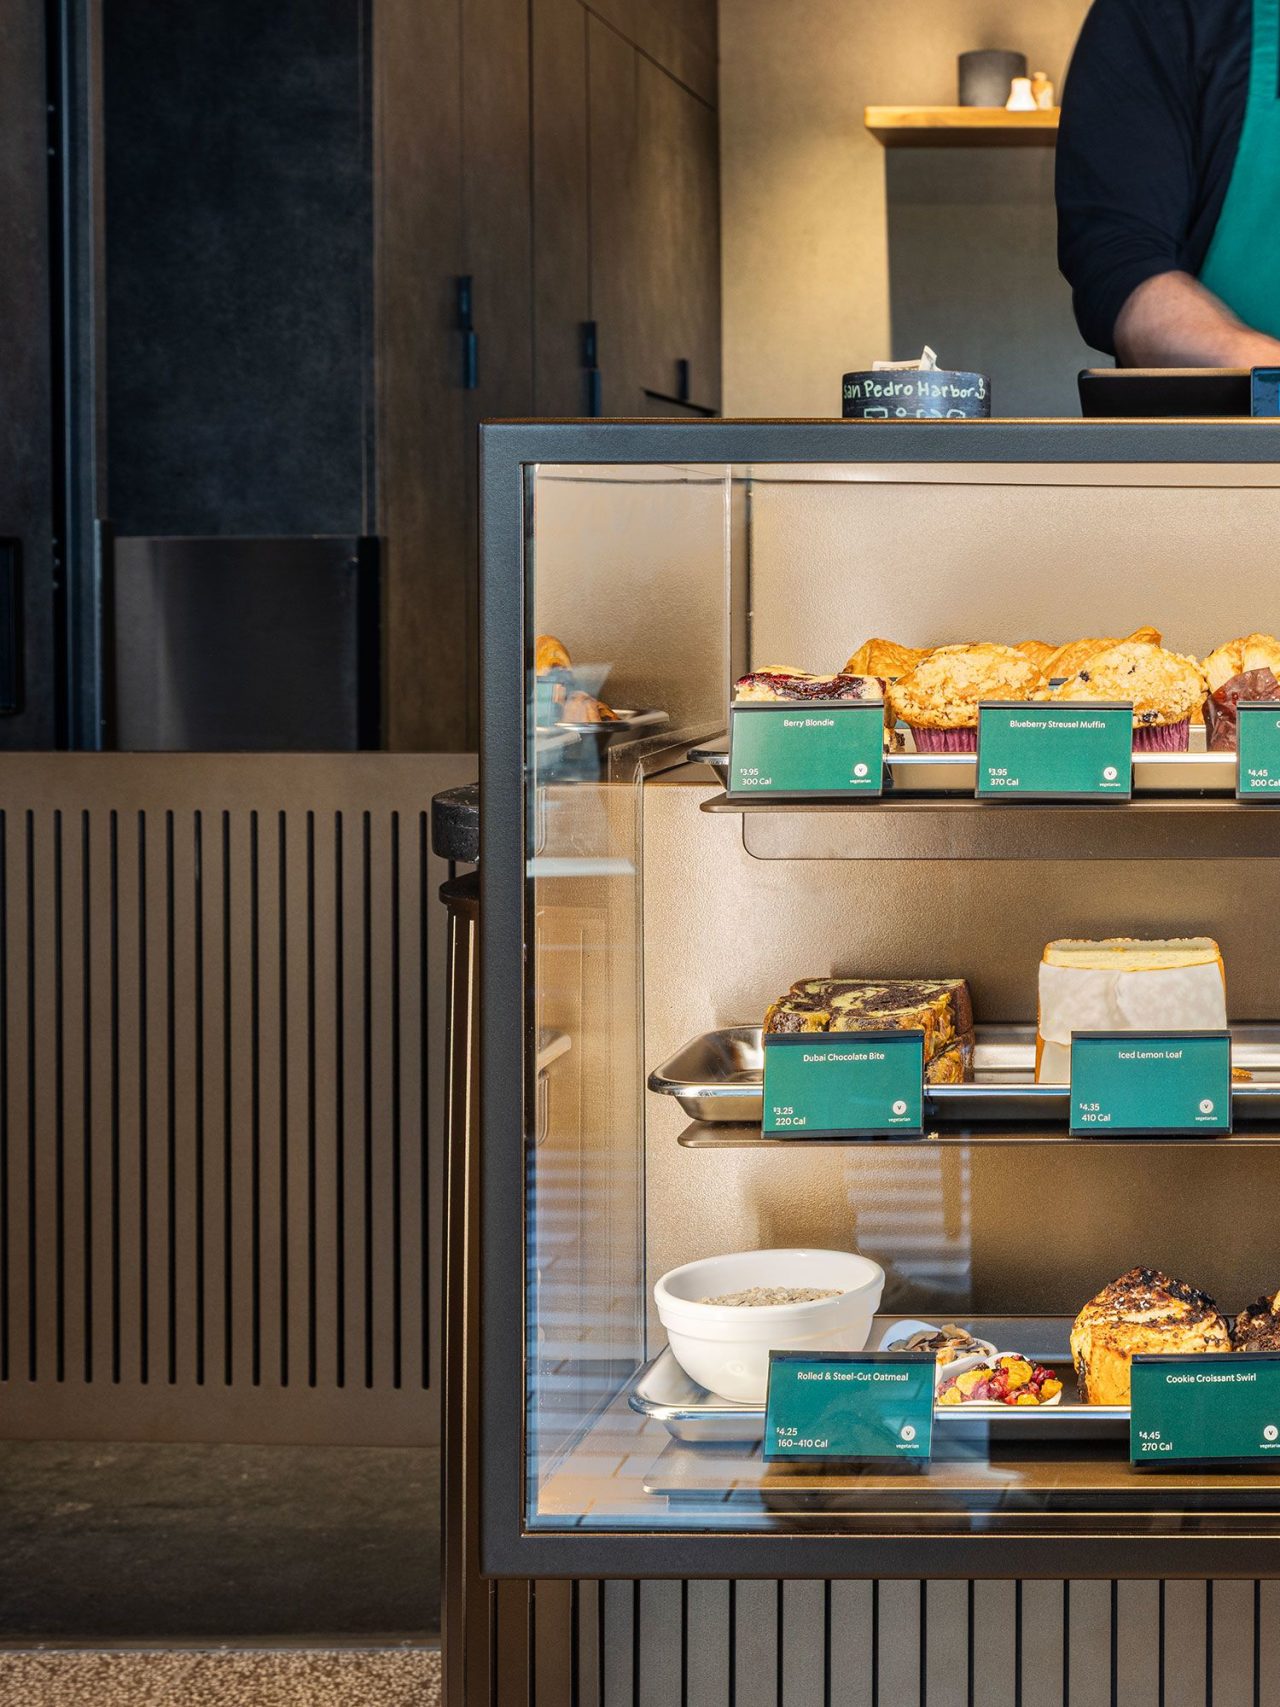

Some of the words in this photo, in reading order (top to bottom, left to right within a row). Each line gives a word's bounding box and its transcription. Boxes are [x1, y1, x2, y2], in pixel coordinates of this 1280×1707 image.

[864, 380, 914, 397] Pedro
[1010, 720, 1047, 729] Blueberry
[989, 768, 1007, 776] $3.95
[804, 1054, 826, 1062] Dubai
[828, 1053, 867, 1061] Chocolate
[869, 1052, 884, 1060] Bite
[1119, 1051, 1135, 1059] Iced
[774, 1107, 793, 1115] $3.25
[1080, 1103, 1099, 1111] $4.35
[793, 1117, 806, 1125] Cal
[798, 1372, 823, 1380] Rolled
[825, 1372, 831, 1380] &
[833, 1372, 871, 1380] Steel-Cut
[873, 1373, 908, 1381] Oatmeal
[1166, 1375, 1195, 1383] Cookie
[1196, 1374, 1235, 1382] Croissant
[1236, 1373, 1256, 1381] Swirl
[777, 1427, 797, 1436] $4.25
[1139, 1431, 1160, 1439] $4.45
[815, 1439, 828, 1447] Cal
[1142, 1443, 1157, 1451] 270
[1159, 1442, 1172, 1450] Cal
